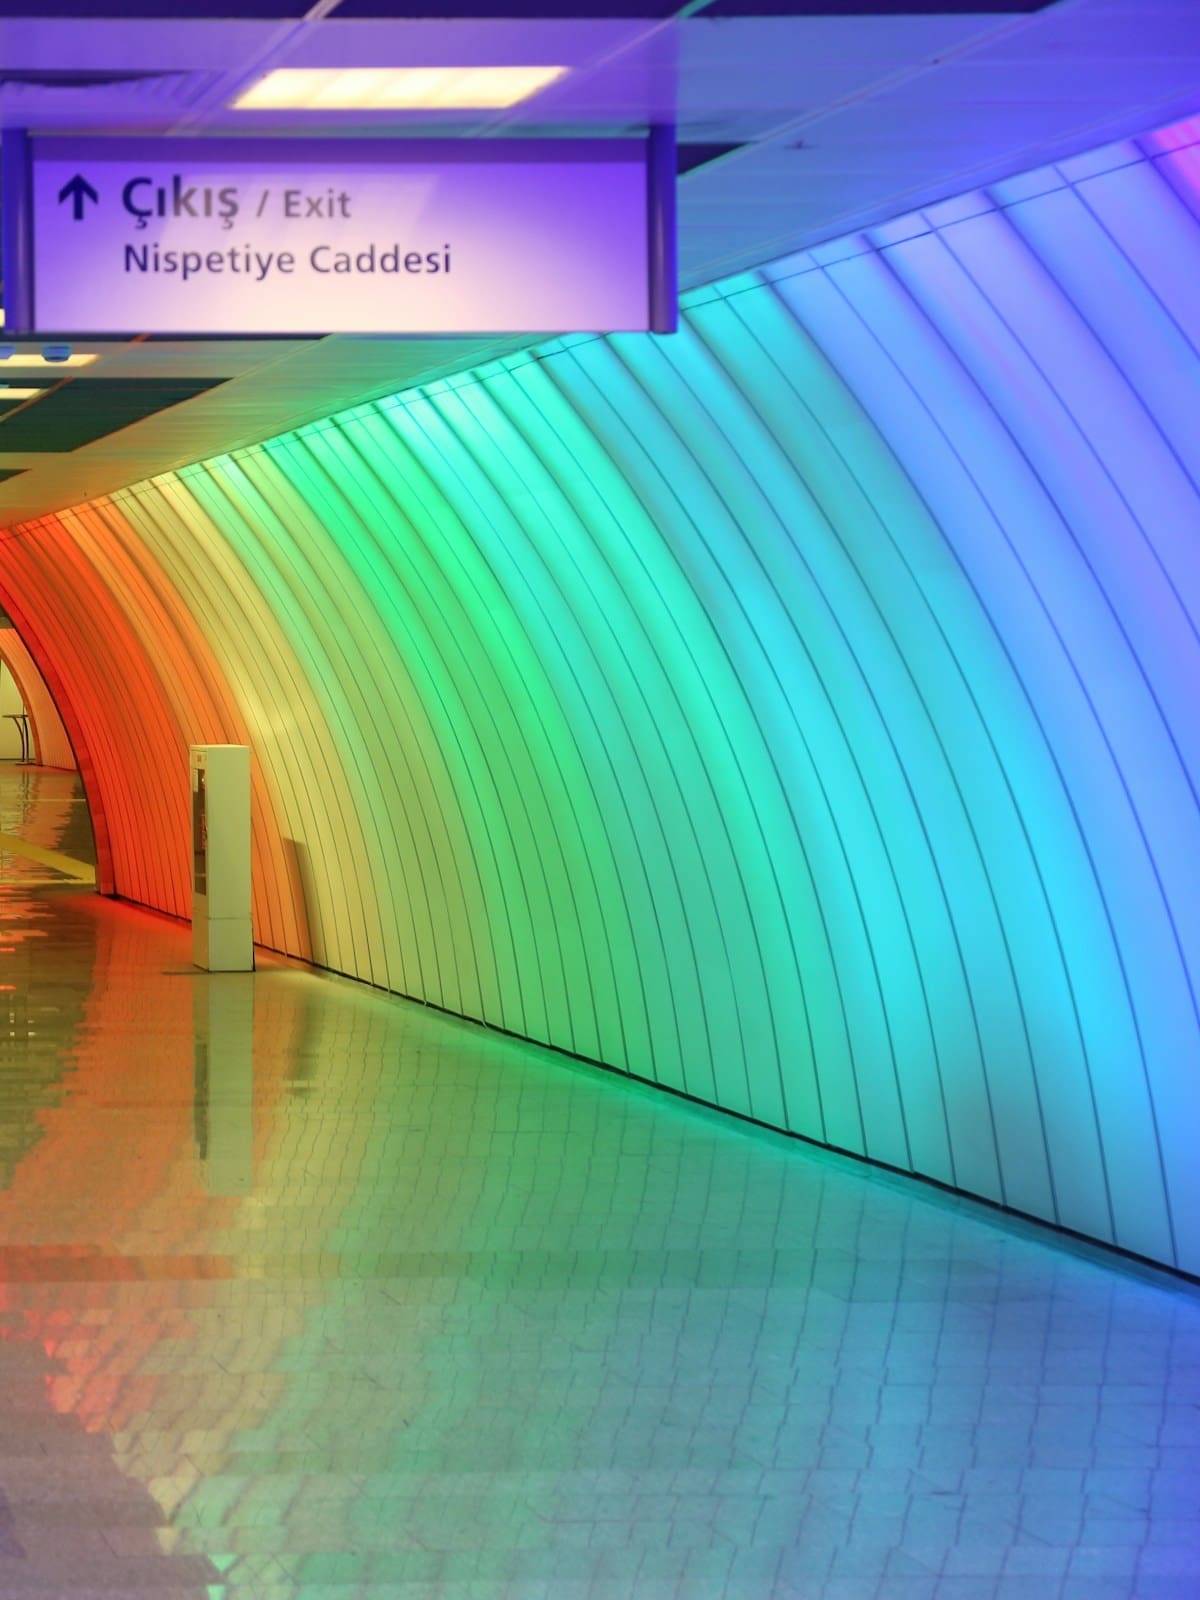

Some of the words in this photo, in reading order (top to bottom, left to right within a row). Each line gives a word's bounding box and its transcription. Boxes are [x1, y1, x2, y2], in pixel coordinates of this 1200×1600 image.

[121, 174, 240, 229] Çıkış
[255, 190, 269, 218] /
[283, 187, 352, 219] Exit
[123, 243, 296, 281] Nispetiye
[309, 243, 453, 274] Caddesi
